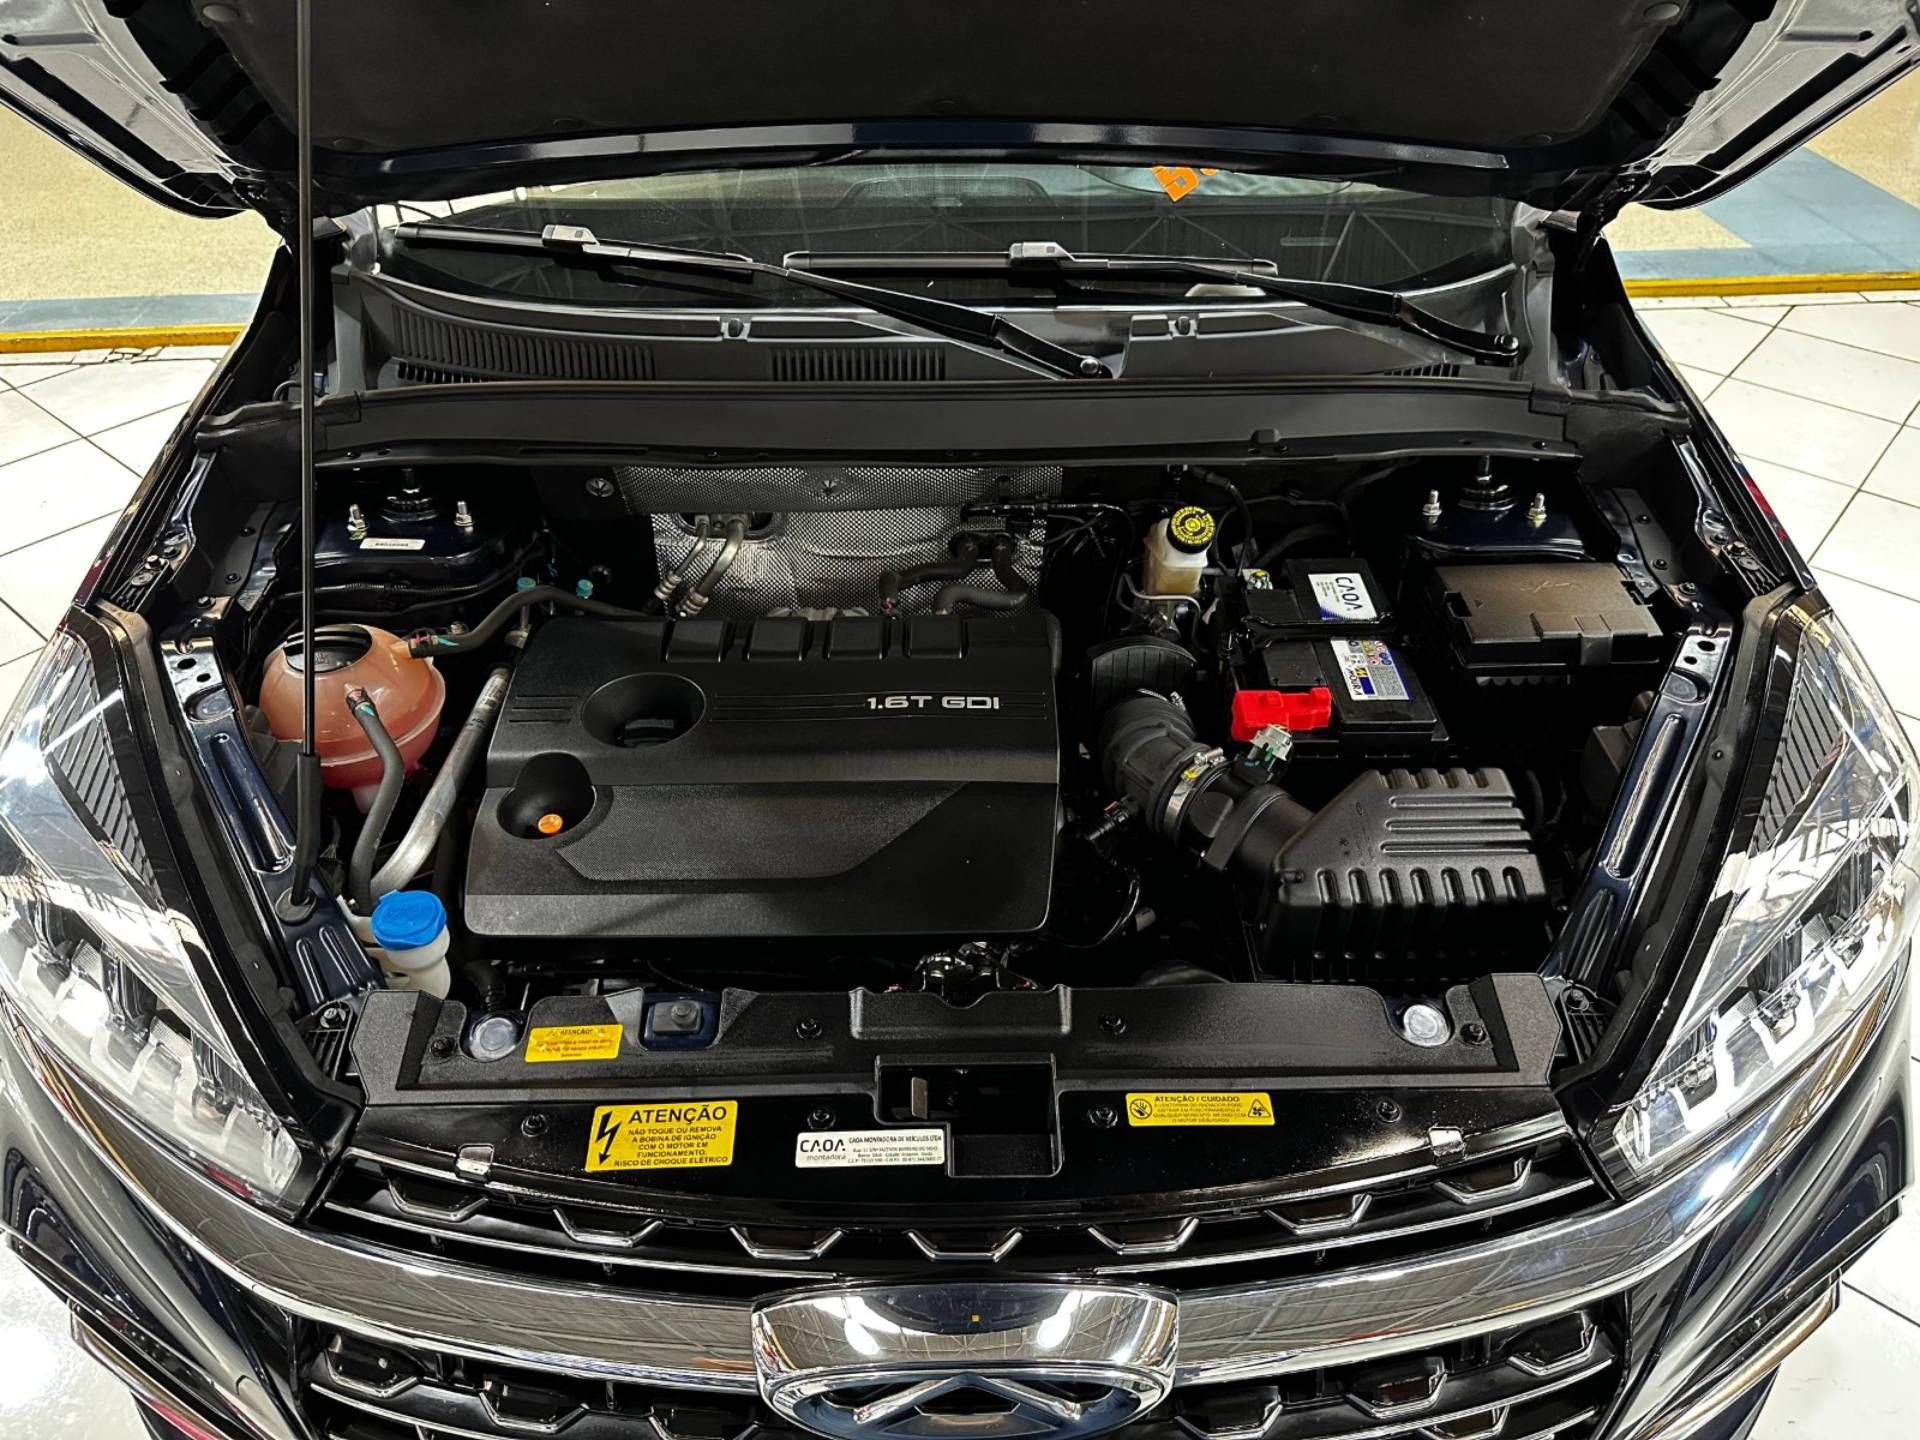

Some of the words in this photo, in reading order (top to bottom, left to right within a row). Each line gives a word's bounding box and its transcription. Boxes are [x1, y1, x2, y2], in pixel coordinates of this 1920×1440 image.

[1335, 576, 1363, 611] CAOA
[866, 695, 933, 710] 1.6T
[941, 696, 1000, 710] GDI
[628, 1104, 727, 1125] ATENÇÃO
[648, 1127, 674, 1135] TOQUE
[684, 1133, 716, 1141] IGNIÇÃO
[800, 1139, 846, 1153] CAOA
[653, 1158, 687, 1166] CHOQUE
[689, 1156, 728, 1164] ELÉTRICO
